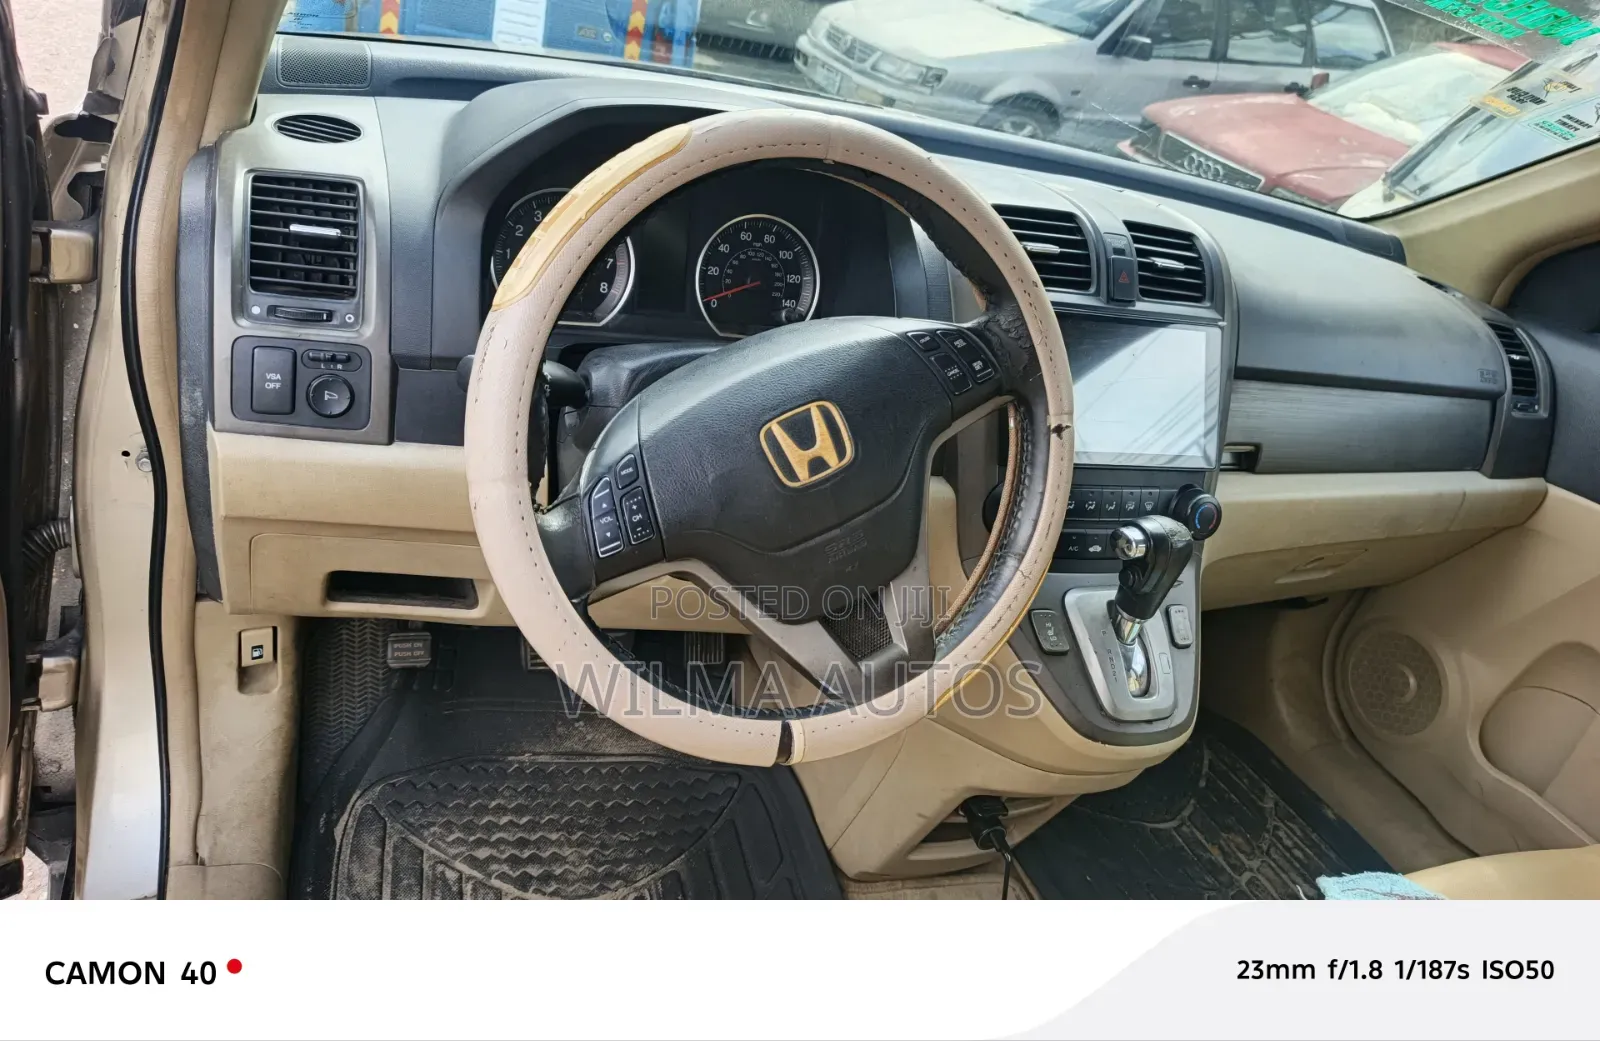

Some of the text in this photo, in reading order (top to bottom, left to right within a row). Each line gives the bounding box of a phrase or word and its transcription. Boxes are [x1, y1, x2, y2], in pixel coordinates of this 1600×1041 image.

[534, 211, 542, 222] 3
[515, 225, 523, 236] 2
[740, 232, 752, 241] 60
[764, 234, 776, 243] 80
[718, 244, 730, 253] 40
[506, 248, 511, 259] 1
[779, 250, 793, 259] 100
[606, 258, 613, 269] 7
[707, 266, 719, 275] 20
[786, 275, 800, 283] 120
[600, 282, 608, 293] 8
[711, 299, 717, 308] 0
[782, 299, 796, 308] 140
[600, 516, 613, 524] VOL
[632, 514, 643, 522] CH
